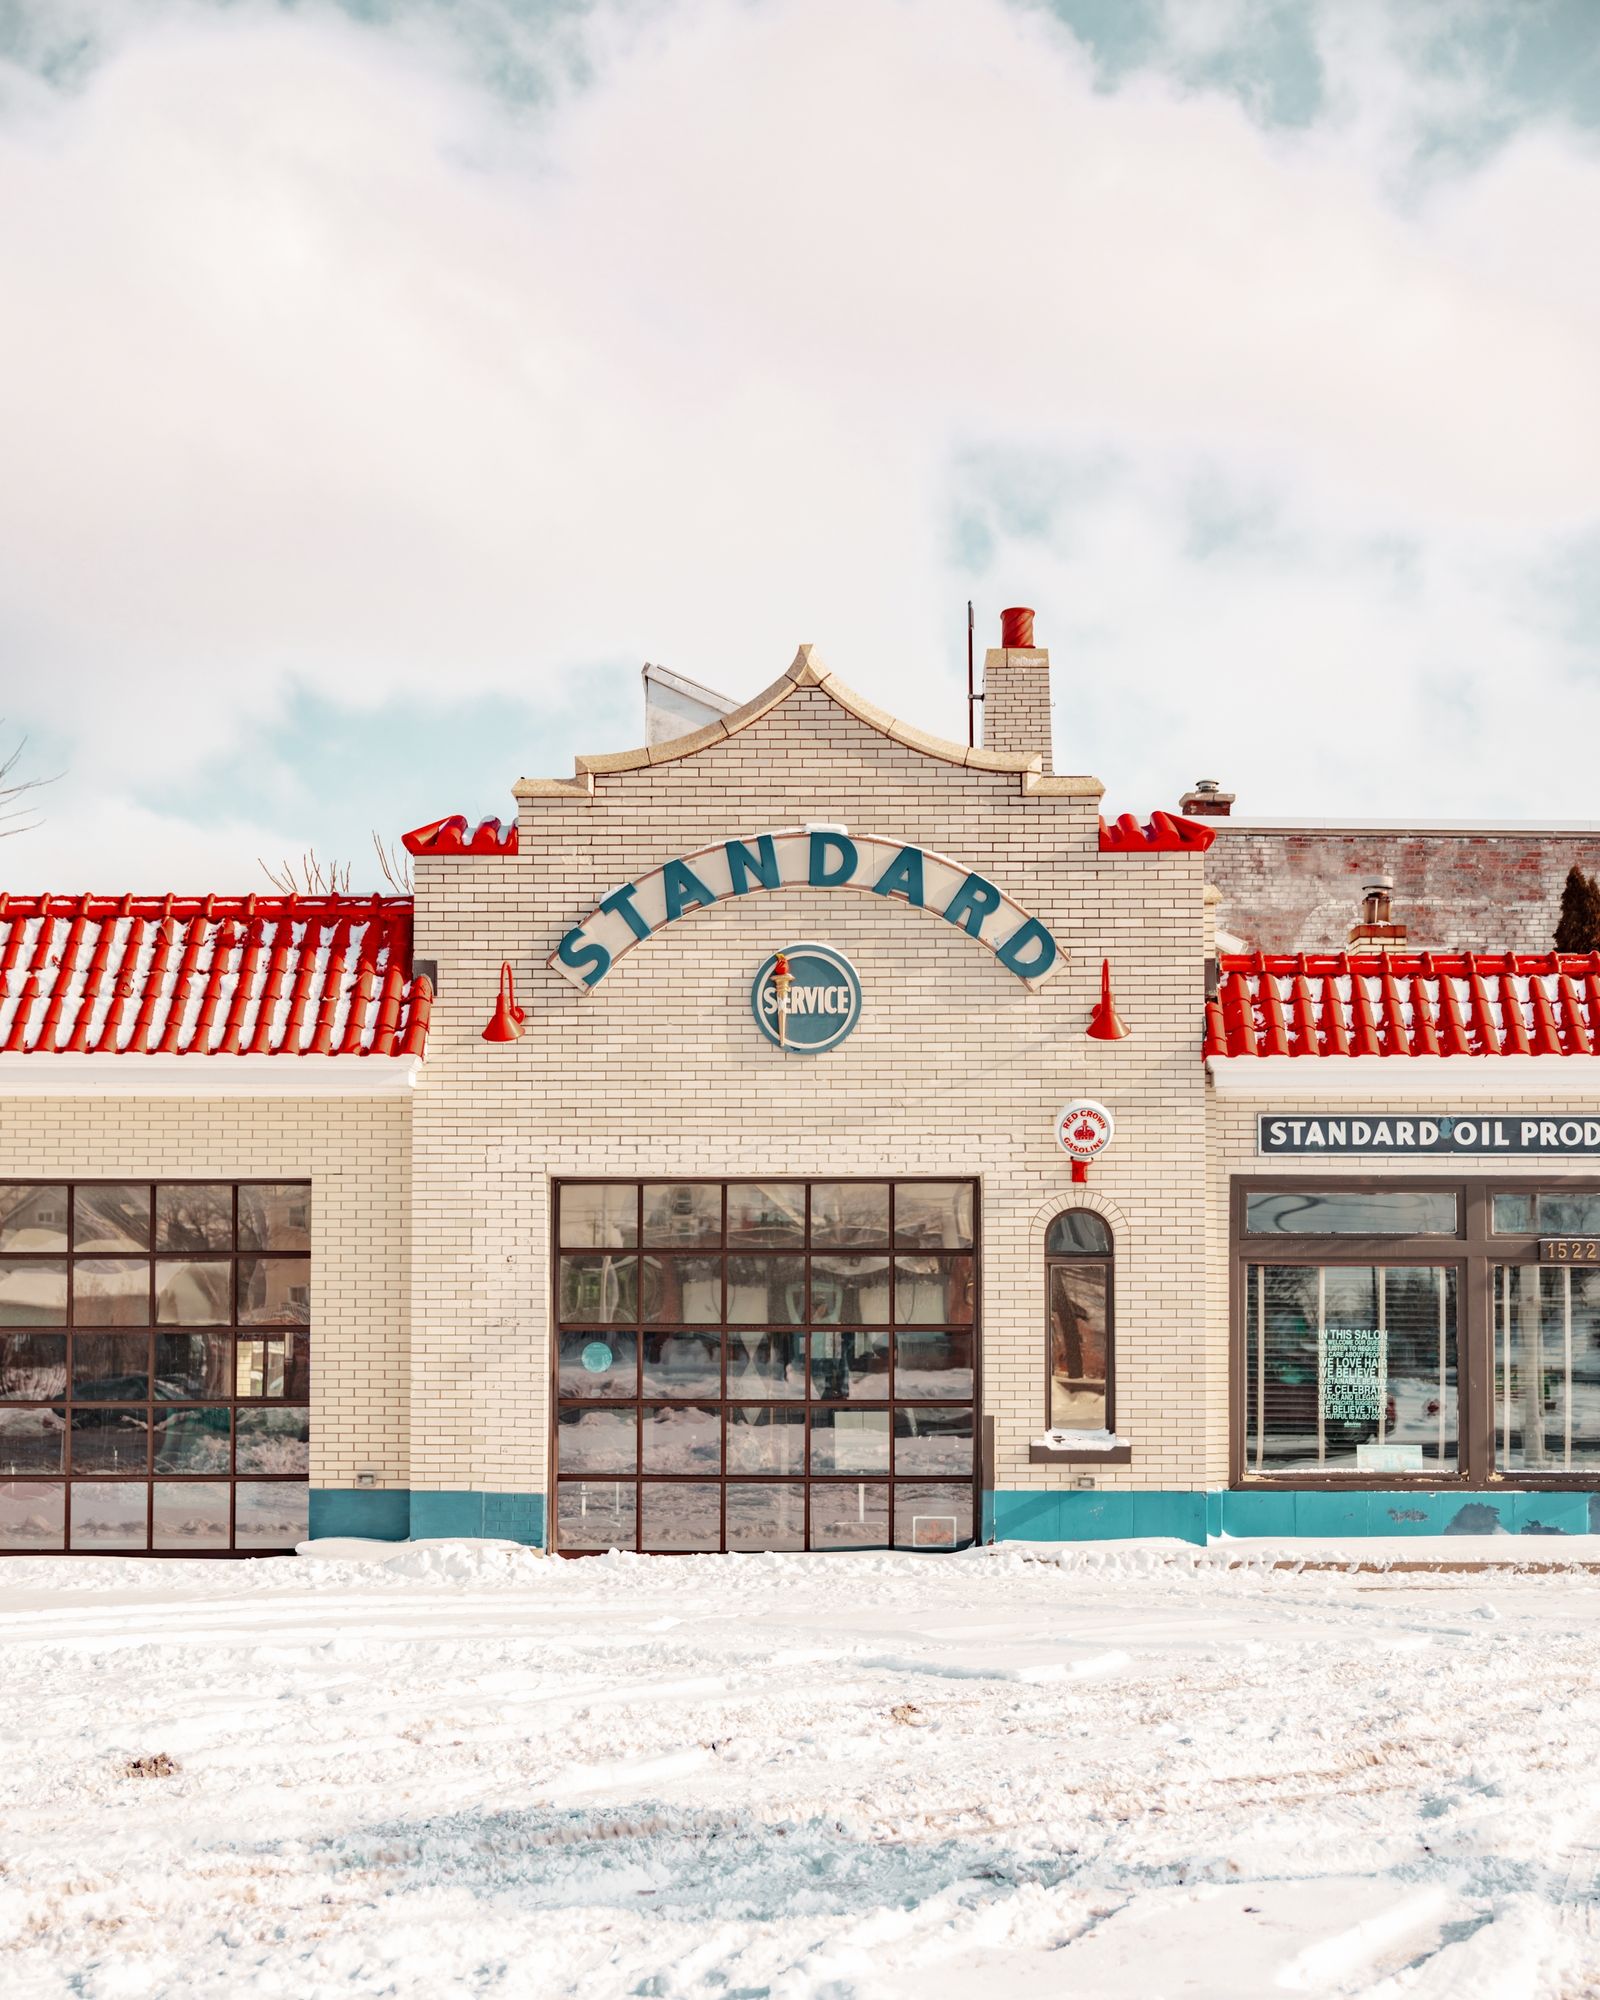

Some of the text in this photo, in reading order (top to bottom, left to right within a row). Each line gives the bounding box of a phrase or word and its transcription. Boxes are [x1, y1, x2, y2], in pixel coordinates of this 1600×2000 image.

[558, 831, 1056, 984] STANDARD
[763, 986, 849, 1015] SERVICE
[1063, 1110, 1107, 1130] RED CROWN
[1269, 1121, 1600, 1146] STANDARD OIL PROD
[1063, 1137, 1105, 1153] GASOLINE
[1547, 1242, 1597, 1259] 1522
[1319, 1330, 1387, 1339] IN THIS SALON
[1319, 1358, 1387, 1367] WE LOVE HAIR
[1319, 1368, 1387, 1377] WE BELIEVE IN
[1319, 1385, 1387, 1394] WE CELEBRATE
